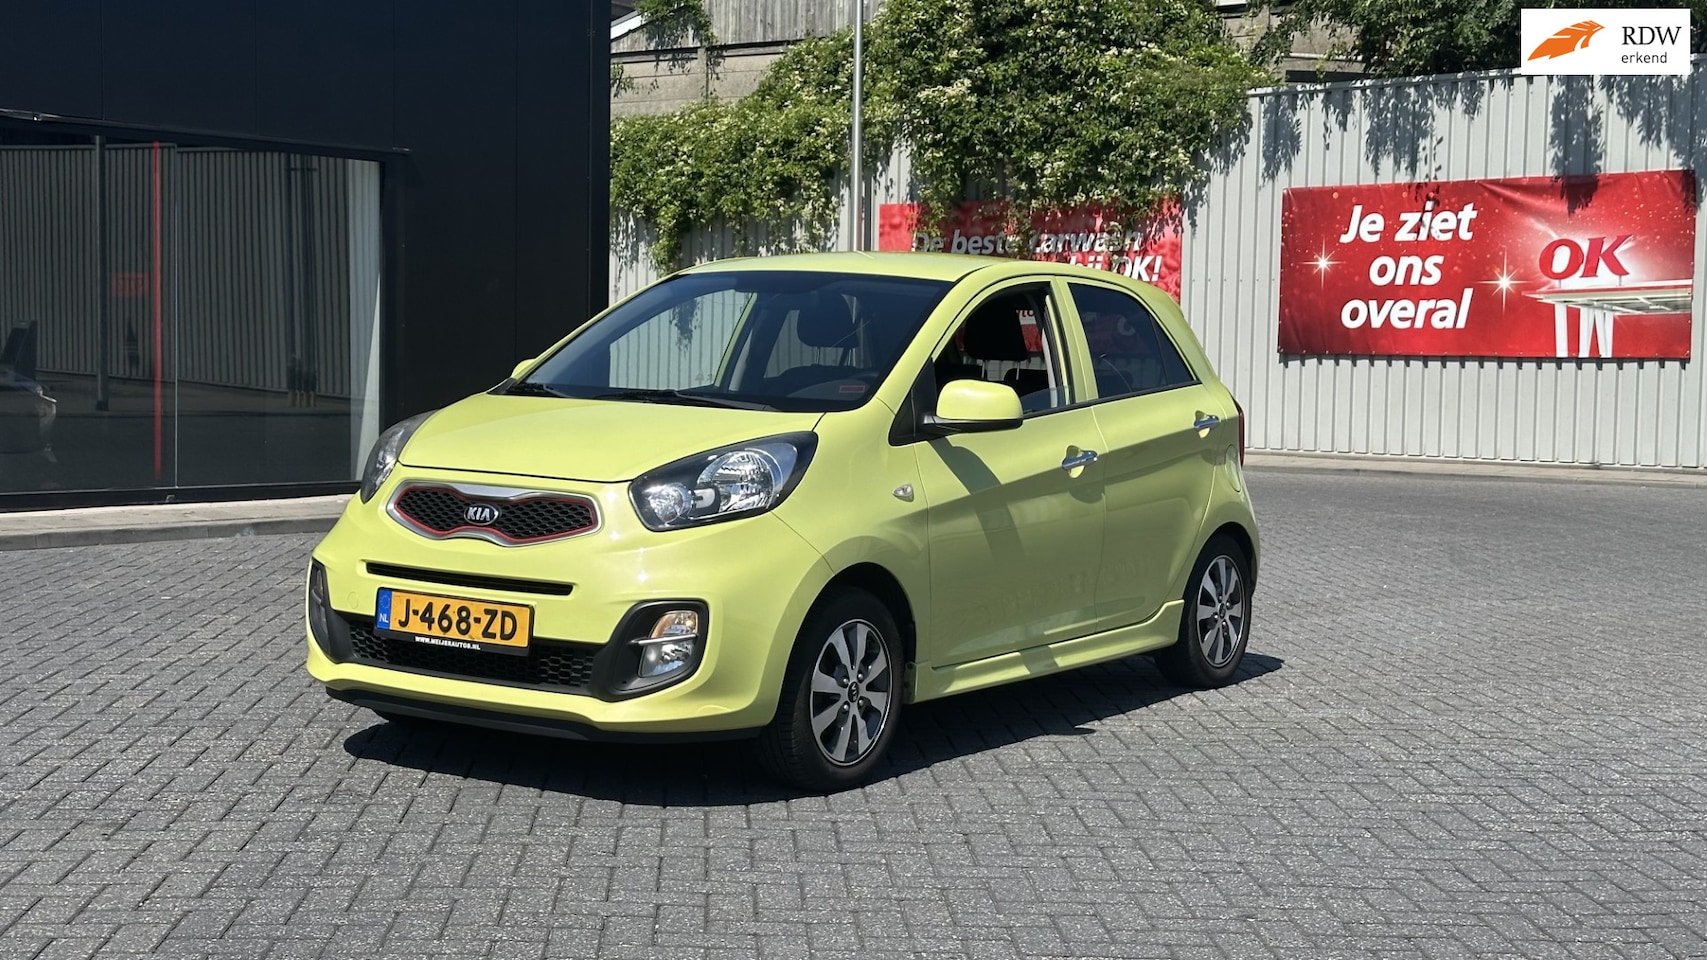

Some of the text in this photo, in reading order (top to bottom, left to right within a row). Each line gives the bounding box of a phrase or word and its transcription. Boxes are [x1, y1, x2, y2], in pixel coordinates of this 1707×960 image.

[1339, 201, 1478, 243] Je ziet
[1029, 230, 1142, 253] arwah
[1539, 234, 1634, 280] OK
[1369, 254, 1444, 286] ons
[1340, 288, 1474, 329] overal
[466, 506, 491, 521] KIA
[379, 613, 389, 623] NL
[398, 598, 518, 641] J-468-ZD
